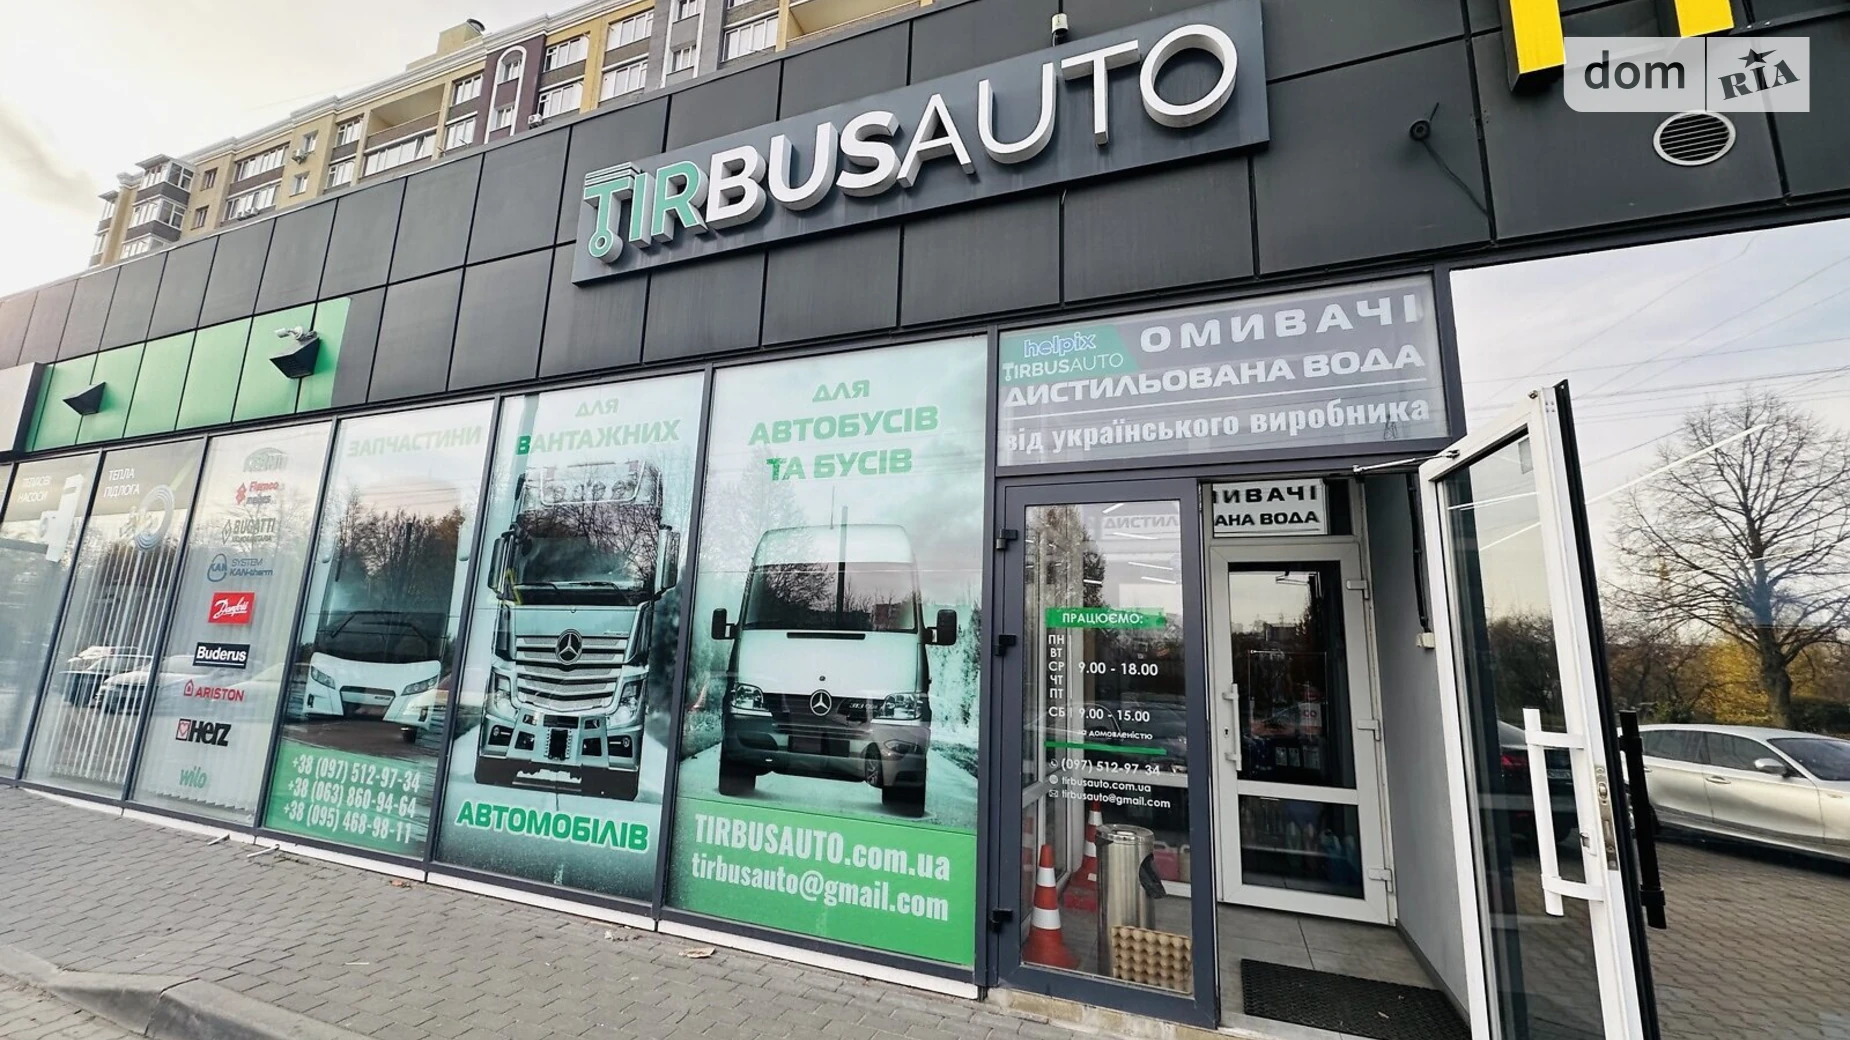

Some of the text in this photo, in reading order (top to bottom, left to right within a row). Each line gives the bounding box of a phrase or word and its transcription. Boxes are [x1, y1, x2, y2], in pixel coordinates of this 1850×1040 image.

[583, 24, 1239, 264] TIRBUSAUTO
[1140, 294, 1417, 353] ОМИВАЧІ
[1024, 332, 1097, 358] helpix
[1002, 353, 1124, 381] TIRBUSAUTO
[1004, 344, 1426, 407] ДИСТИЛЬОВАНА ВОДА
[812, 380, 870, 403] ДЛЯ
[575, 398, 619, 418] ДЛЯ
[748, 406, 939, 446] АВТОБУСІВ
[1007, 398, 1431, 455] від українського виробника
[347, 425, 483, 458] ЗАПЧАСТИНИ
[515, 419, 681, 455] ВАНТАЖНИХ
[766, 448, 913, 481] ТА БУСІВ
[108, 468, 135, 482] ТЕПЛА
[103, 484, 140, 498] ПІДЛОГА
[233, 517, 276, 535] BUGATTI
[1259, 510, 1321, 525] ВОДА
[231, 558, 263, 567] SYSTEM
[1062, 612, 1144, 625] ПРАЦЮЄМО:
[1048, 634, 1065, 645] ПН
[196, 646, 247, 663] Buderus
[1050, 647, 1063, 658] ВТ
[1048, 661, 1065, 672] СР
[1078, 661, 1107, 674] 9.00
[1121, 662, 1159, 676] 18.00
[1050, 674, 1063, 685] ЧТ
[195, 686, 245, 703] ARISTON
[1049, 687, 1063, 699] ПТ
[1048, 706, 1066, 717] СБ
[1078, 708, 1104, 720] 9.00
[1117, 710, 1151, 723] 15.00
[292, 754, 421, 793] +38 (097) 512-97-34
[1061, 757, 1161, 777] (097) 512-9734
[179, 766, 208, 789] wilo
[1062, 775, 1152, 793] tirbusauto.com.ua
[288, 777, 417, 818] +38 (063) 860-94-64
[1062, 788, 1171, 809] tirbusauto@gmail.com
[283, 800, 412, 844] +38 (095) 468-98-11
[455, 801, 649, 853] АВТОМОБІЛІВ
[695, 813, 950, 882] TIRBUSAUTO.com.ua
[691, 851, 949, 921] tirbusauto@gmail.com
